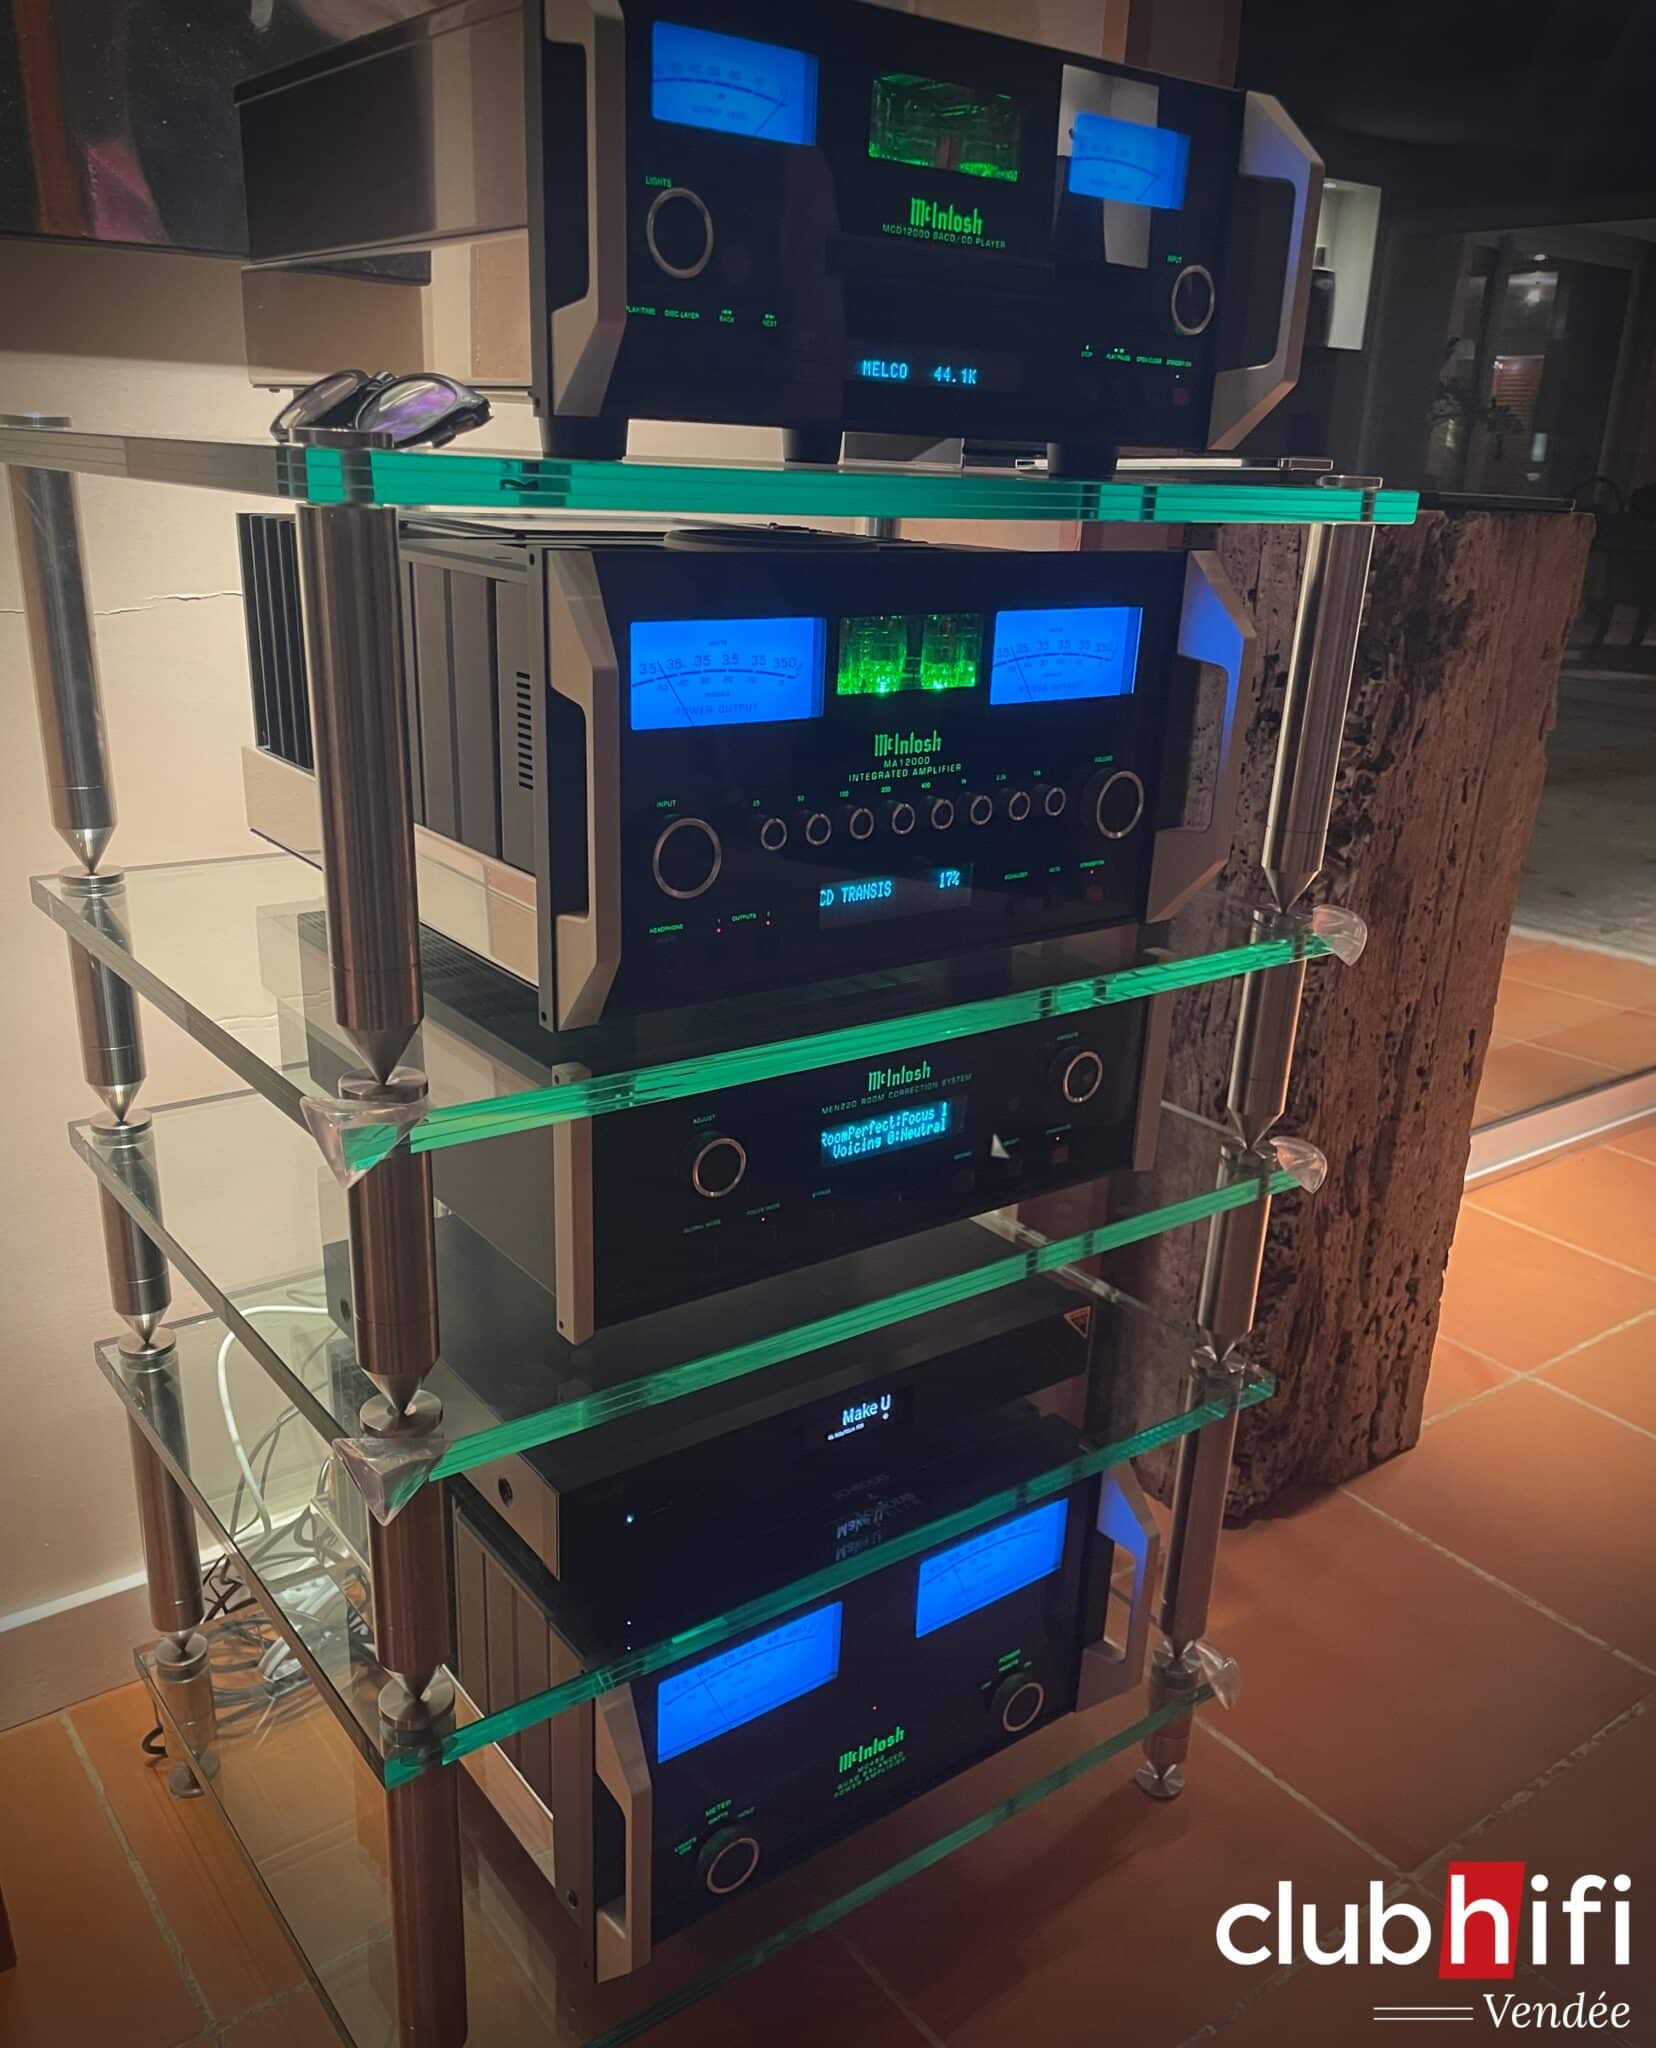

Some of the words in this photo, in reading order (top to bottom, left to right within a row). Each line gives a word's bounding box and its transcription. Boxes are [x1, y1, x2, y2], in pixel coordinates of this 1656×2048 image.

[911, 197, 982, 235] McIntosh
[975, 238, 1006, 249] PLAYER
[933, 366, 977, 384] 44.1K
[874, 730, 942, 757] McIntosh
[848, 769, 909, 782] INTEGRATED
[912, 763, 962, 776] AMPLIFIER
[884, 756, 930, 769] MA12000
[841, 880, 893, 904] TRANSIS
[868, 1060, 931, 1092] McIntosh
[861, 1093, 885, 1105] ROOM
[888, 1082, 938, 1099] CORRECTION
[832, 1136, 882, 1159] Voicing
[841, 1402, 879, 1427] Make
[880, 1394, 892, 1412] U
[838, 1726, 905, 1774] McIntosh
